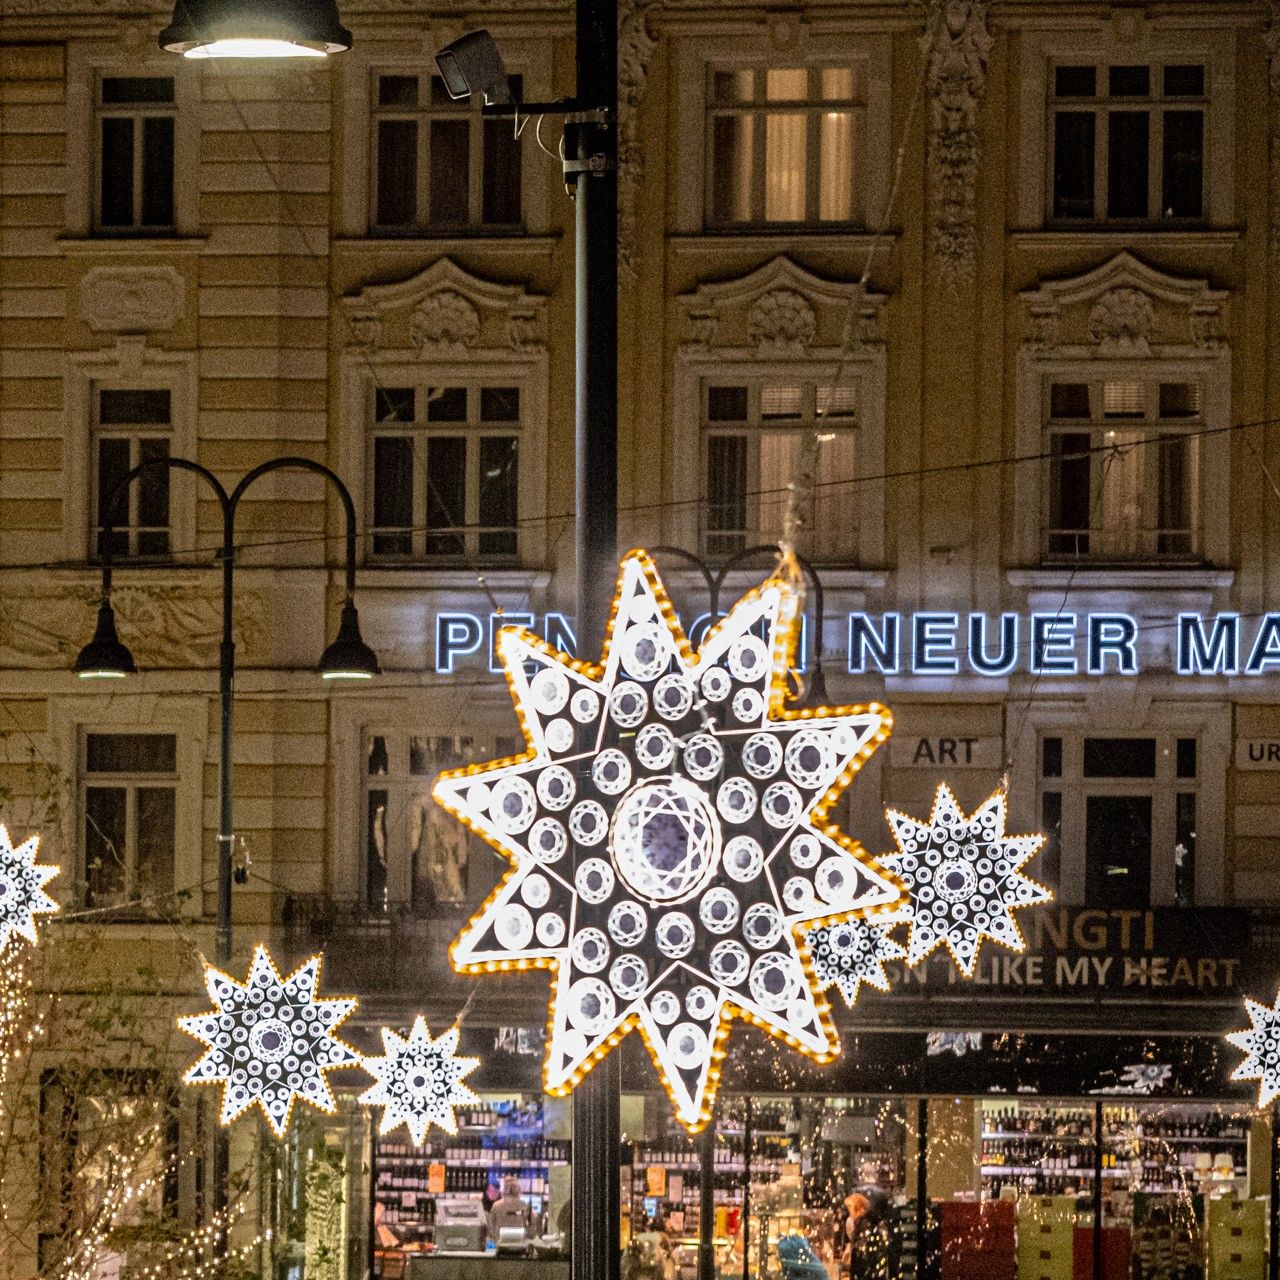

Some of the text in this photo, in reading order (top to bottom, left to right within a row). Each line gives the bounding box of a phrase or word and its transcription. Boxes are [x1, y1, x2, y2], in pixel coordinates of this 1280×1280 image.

[847, 611, 1139, 675] NEUER
[912, 738, 979, 764] ART
[974, 956, 1044, 986] LIKE
[1055, 956, 1120, 986] MY
